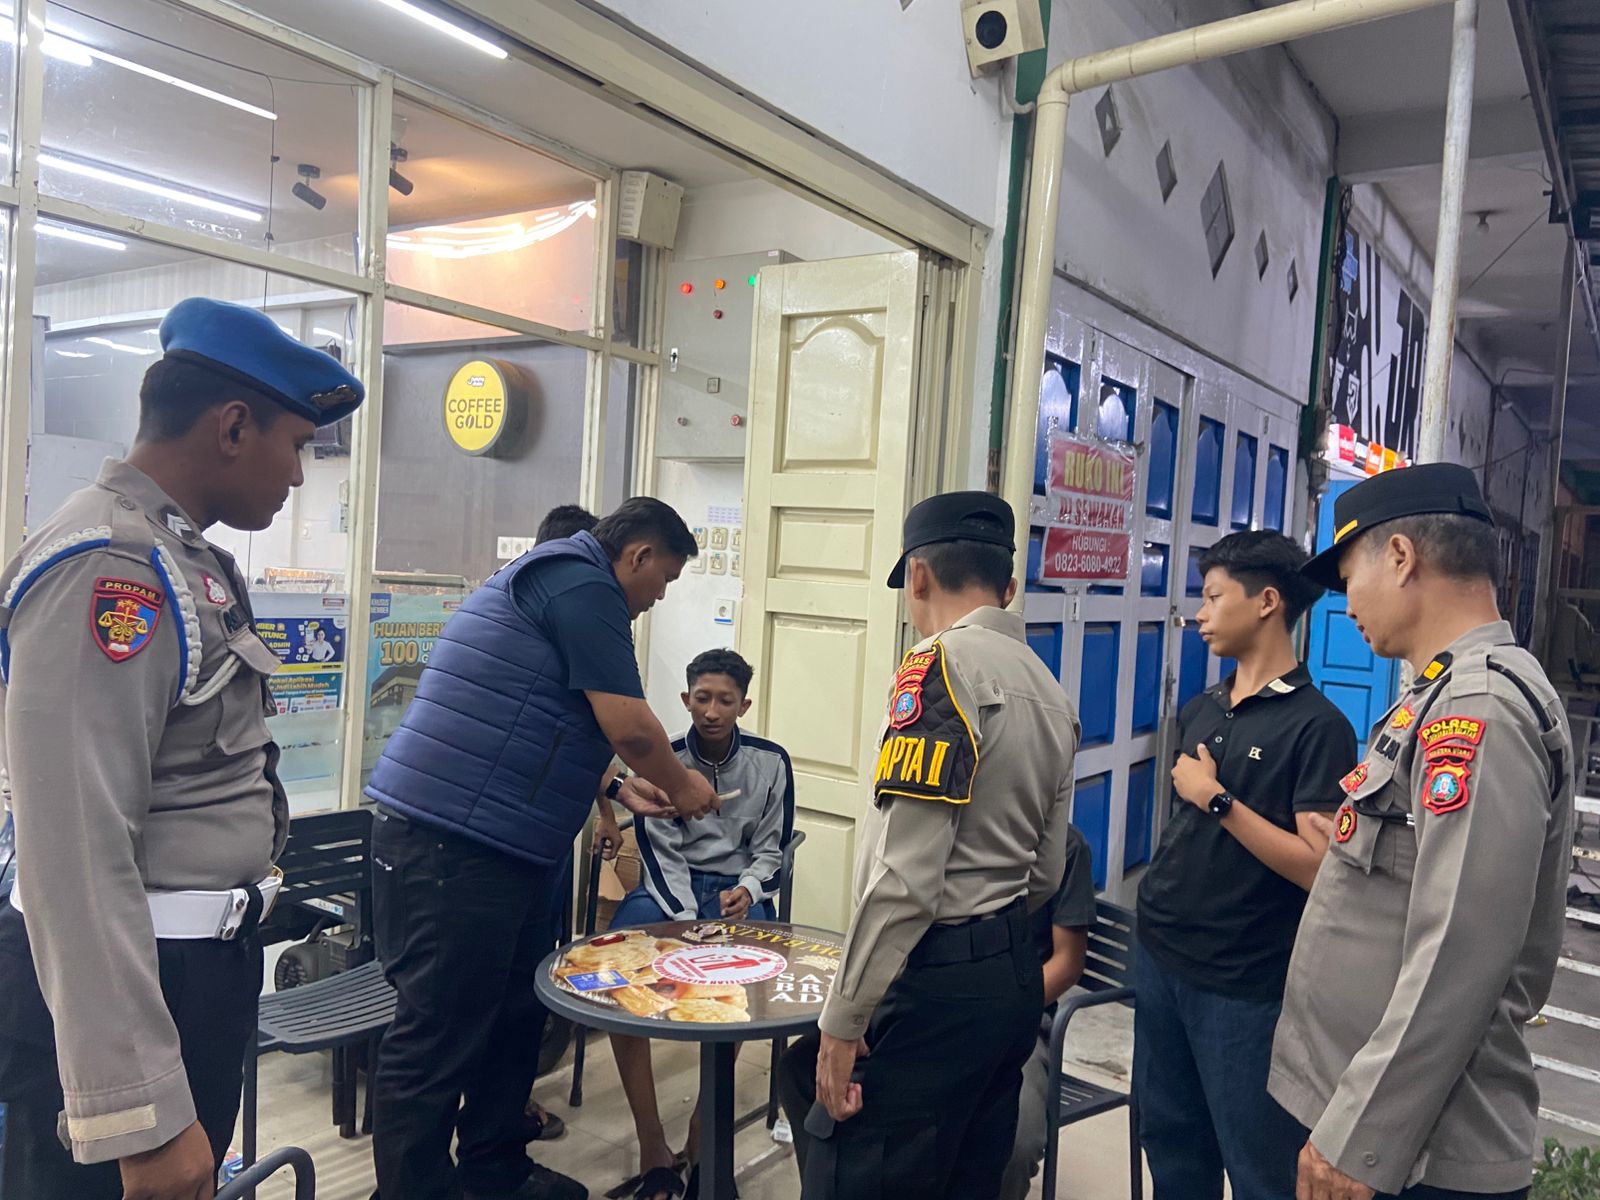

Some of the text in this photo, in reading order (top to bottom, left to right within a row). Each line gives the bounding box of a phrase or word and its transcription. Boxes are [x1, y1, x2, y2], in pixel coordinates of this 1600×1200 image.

[448, 398, 502, 413] COFFEE
[455, 414, 494, 429] GOLD
[1064, 450, 1125, 495] RUKO INI
[1055, 552, 1121, 574] 0823-6080-4932
[105, 581, 157, 600] PROPAM
[374, 623, 417, 638] HUJAN
[380, 640, 419, 666] 100
[1421, 718, 1480, 740] POLRES
[873, 736, 951, 787] APTA II
[774, 982, 830, 994] BR
